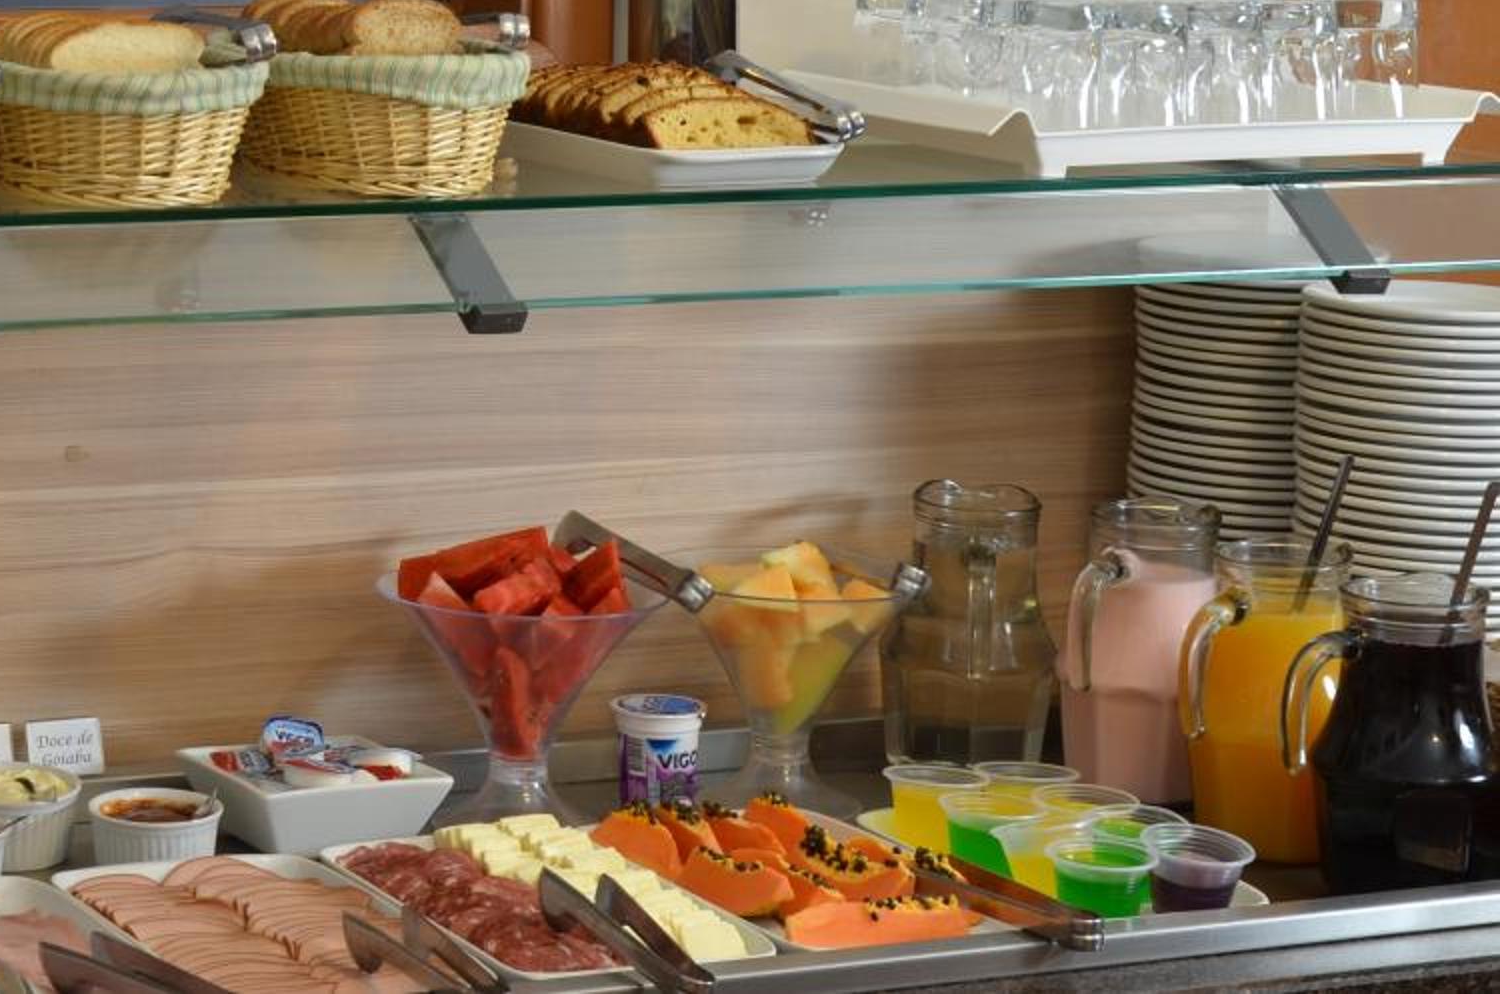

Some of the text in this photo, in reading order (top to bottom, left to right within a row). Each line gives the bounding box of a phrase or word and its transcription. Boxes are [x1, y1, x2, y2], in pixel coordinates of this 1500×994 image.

[37, 729, 94, 749] Doce de
[41, 747, 93, 766] Goiaba
